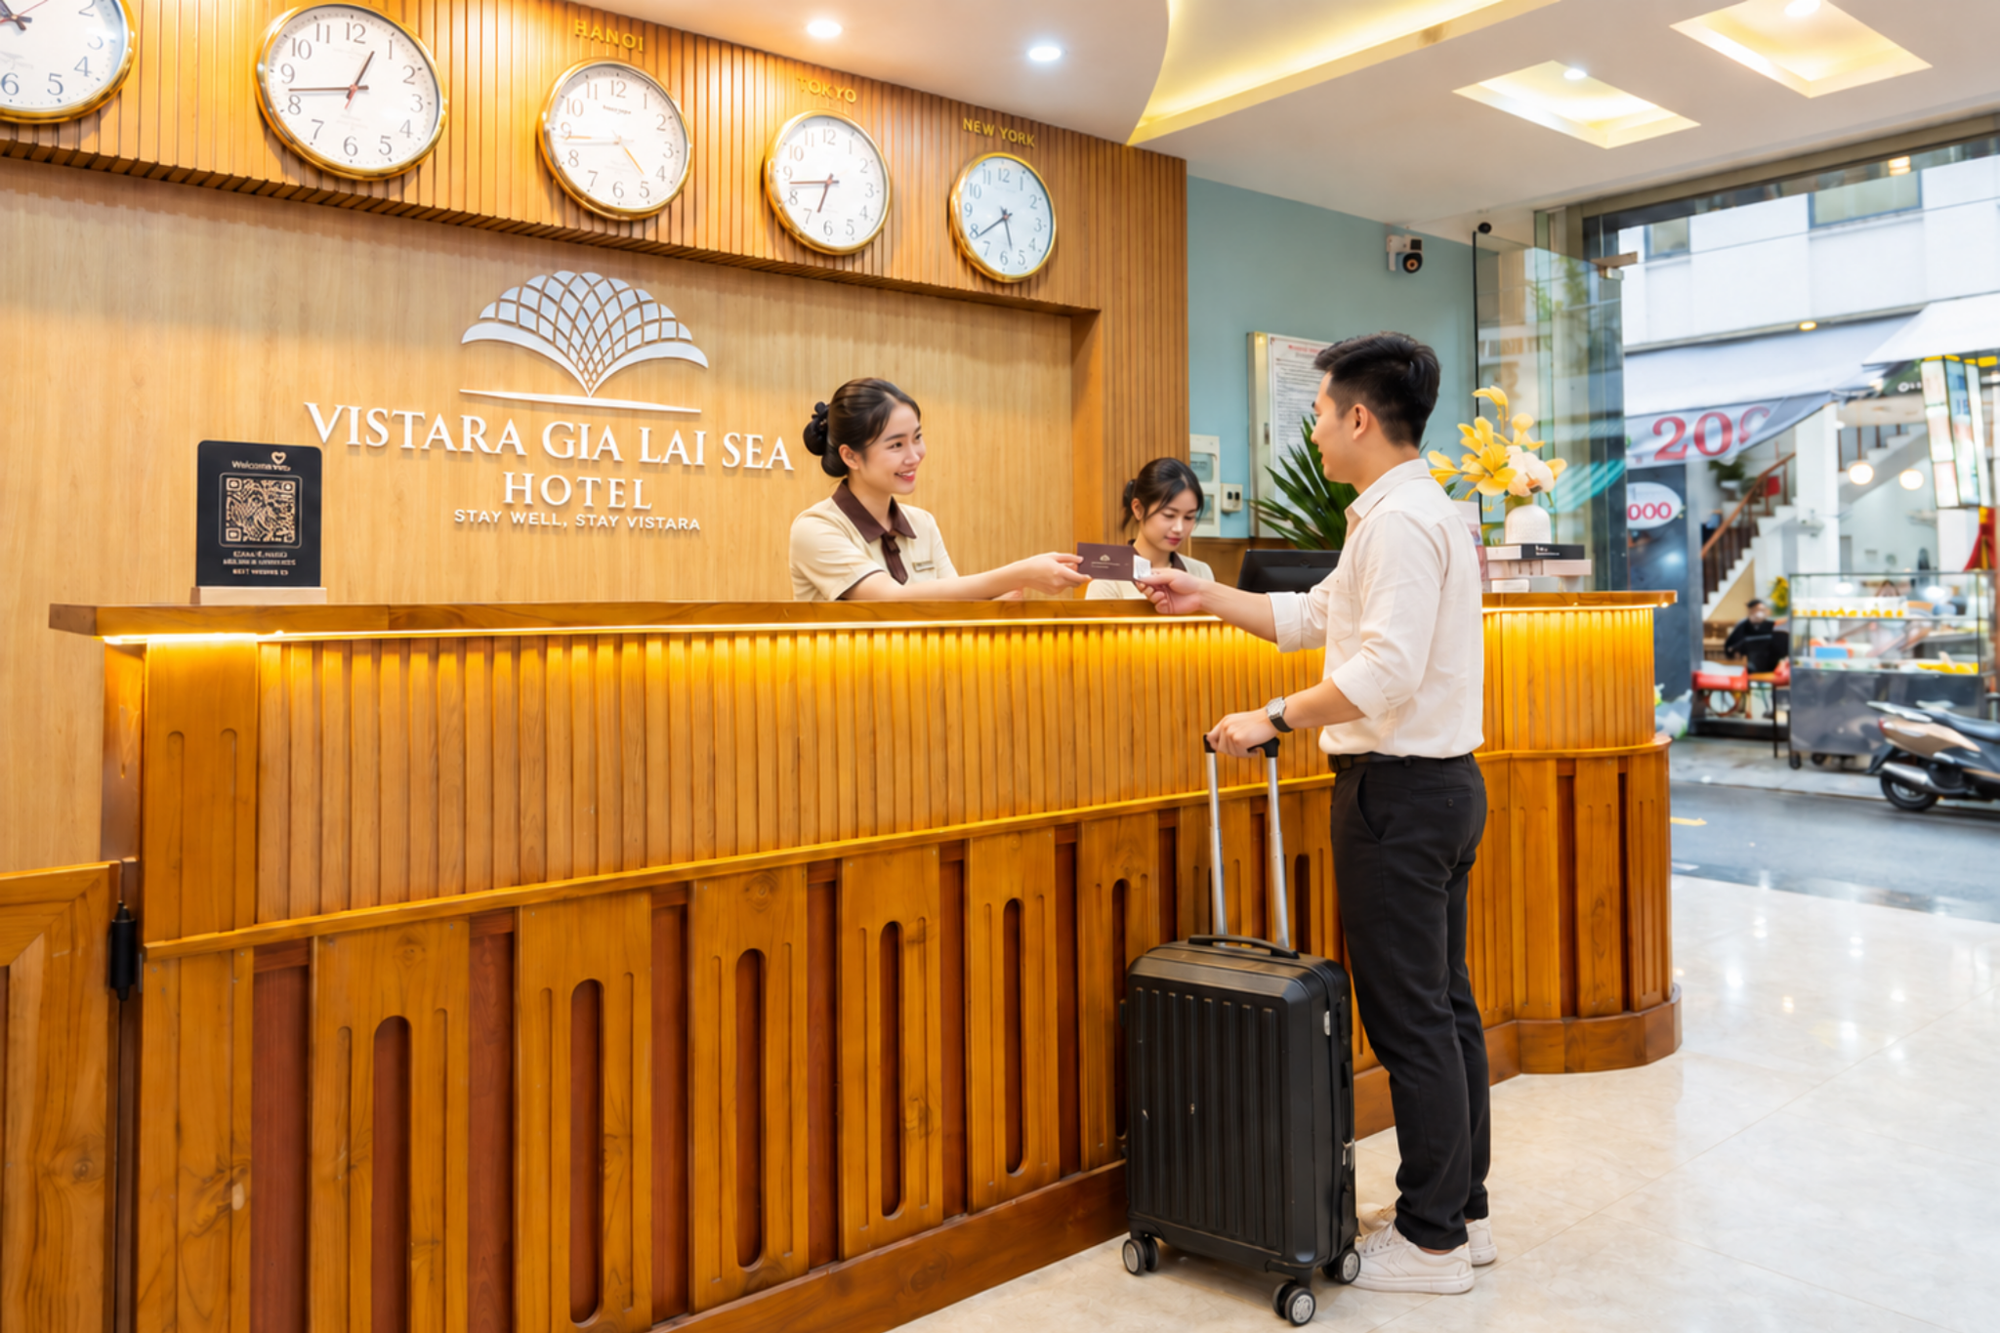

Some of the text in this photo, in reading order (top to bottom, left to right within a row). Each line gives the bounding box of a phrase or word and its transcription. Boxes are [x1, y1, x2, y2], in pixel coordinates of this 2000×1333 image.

[316, 23, 330, 44] 11
[346, 22, 366, 44] 12
[574, 19, 644, 51] HANOI
[292, 37, 312, 60] 10
[388, 39, 393, 60] 1
[74, 56, 93, 77] 4
[280, 63, 295, 84] 9
[403, 65, 416, 85] 2
[1, 72, 19, 96] 6
[47, 73, 64, 95] 5
[586, 81, 598, 100] 11
[610, 80, 627, 98] 12
[797, 77, 857, 103] TOKYO
[287, 95, 301, 115] 8
[410, 94, 424, 113] 3
[566, 97, 584, 117] 10
[311, 119, 324, 140] 7
[399, 119, 414, 139] 4
[561, 122, 572, 140] 9
[656, 114, 666, 131] 2
[804, 130, 814, 147] 11
[823, 128, 836, 145] 12
[962, 117, 1035, 148] NEW YORK
[343, 136, 358, 157] 6
[378, 135, 392, 156] 5
[663, 141, 674, 159] 3
[789, 144, 804, 161] 10
[568, 149, 579, 168] 8
[860, 158, 868, 173] 2
[587, 170, 599, 187] 7
[656, 165, 667, 182] 4
[783, 166, 793, 181] 9
[983, 169, 991, 185] 11
[998, 168, 1010, 183] 12
[613, 181, 624, 199] 6
[639, 181, 650, 198] 5
[789, 189, 798, 205] 8
[865, 183, 874, 198] 3
[969, 183, 982, 199] 10
[964, 202, 973, 217] 9
[1030, 194, 1037, 209] 2
[803, 208, 812, 225] 7
[859, 205, 869, 220] 4
[823, 220, 833, 236] 6
[846, 219, 855, 236] 5
[969, 223, 979, 239] 8
[1034, 218, 1042, 232] 3
[983, 241, 991, 257] 7
[1028, 238, 1036, 251] 4
[1000, 251, 1008, 266] 6
[1018, 250, 1026, 266] 5
[304, 401, 795, 471] VISTARA GIA LAI SEA
[502, 472, 652, 511] HOTEL
[454, 508, 701, 531] STAY WELL, STAY VISTARA
